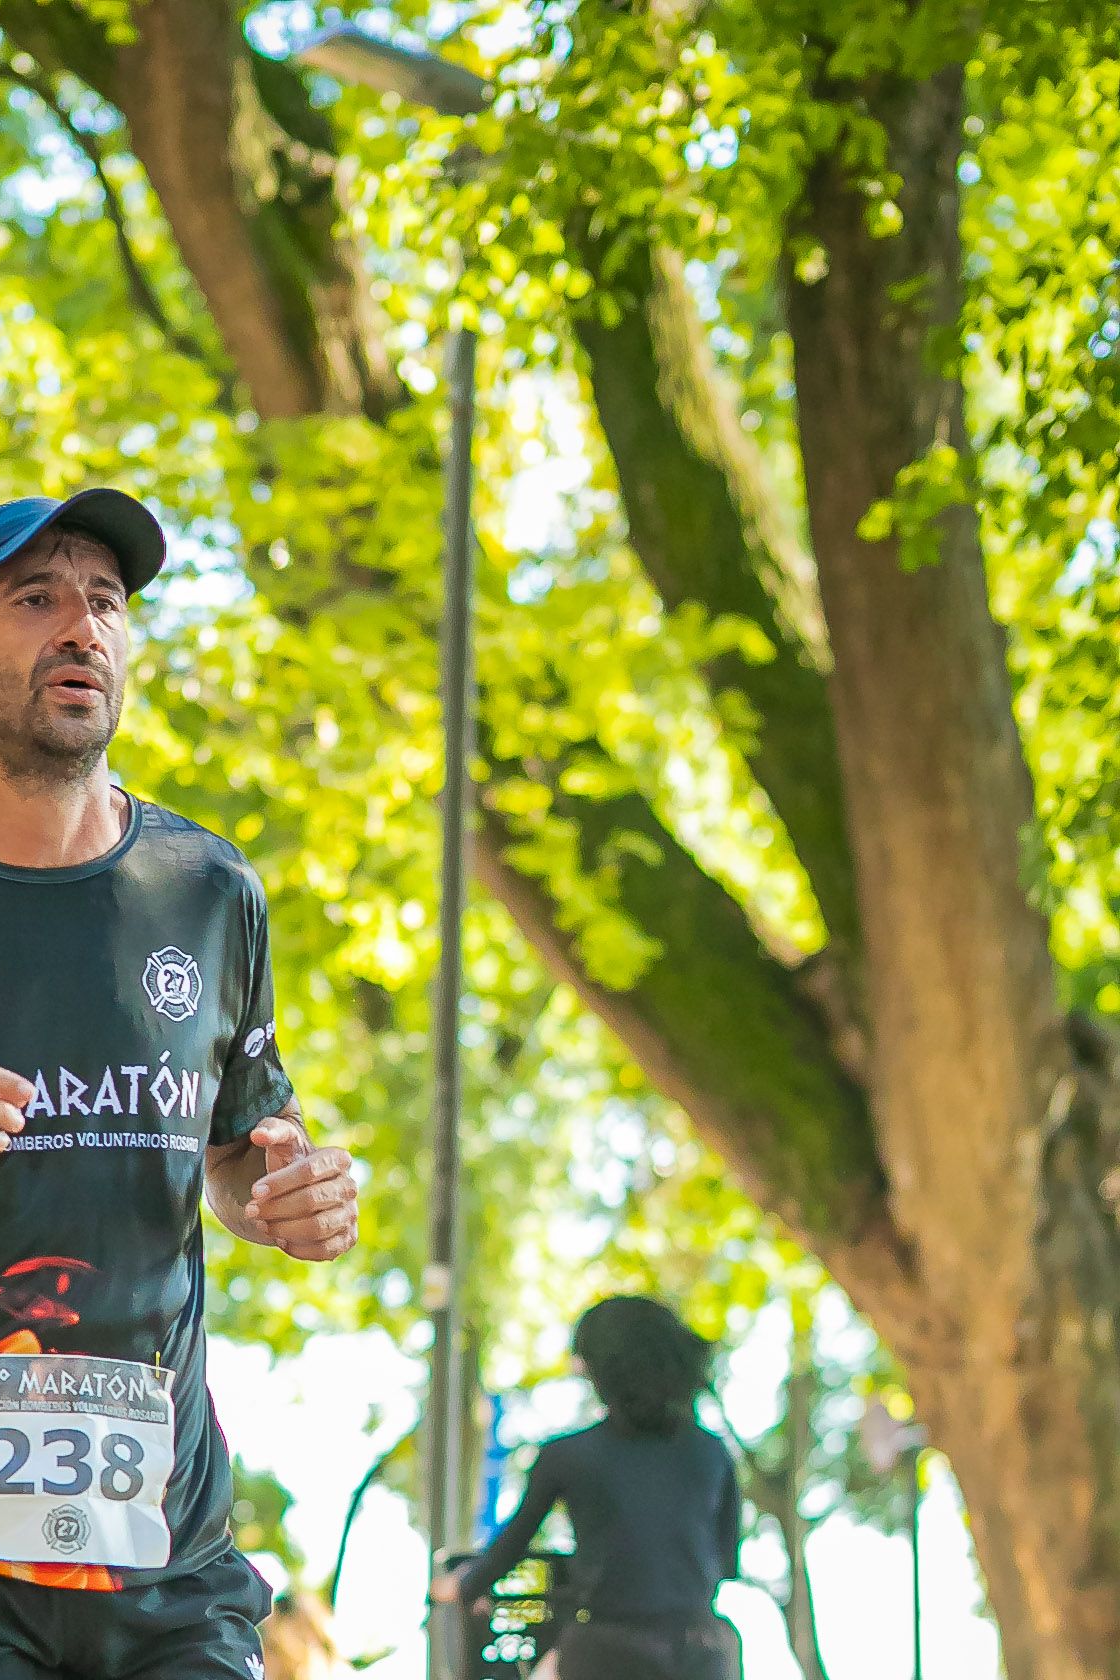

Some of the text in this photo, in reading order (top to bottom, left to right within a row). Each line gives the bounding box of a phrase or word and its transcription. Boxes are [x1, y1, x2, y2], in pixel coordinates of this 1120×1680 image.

[164, 969, 185, 993] 27
[25, 1050, 200, 1119] ARATÓN
[5, 1133, 74, 1151] MBEROS
[76, 1131, 169, 1149] VOLUNTARIOS
[18, 1367, 145, 1402] MARATÓN
[128, 1407, 166, 1423] ROSARIO
[57, 1518, 78, 1537] 27
